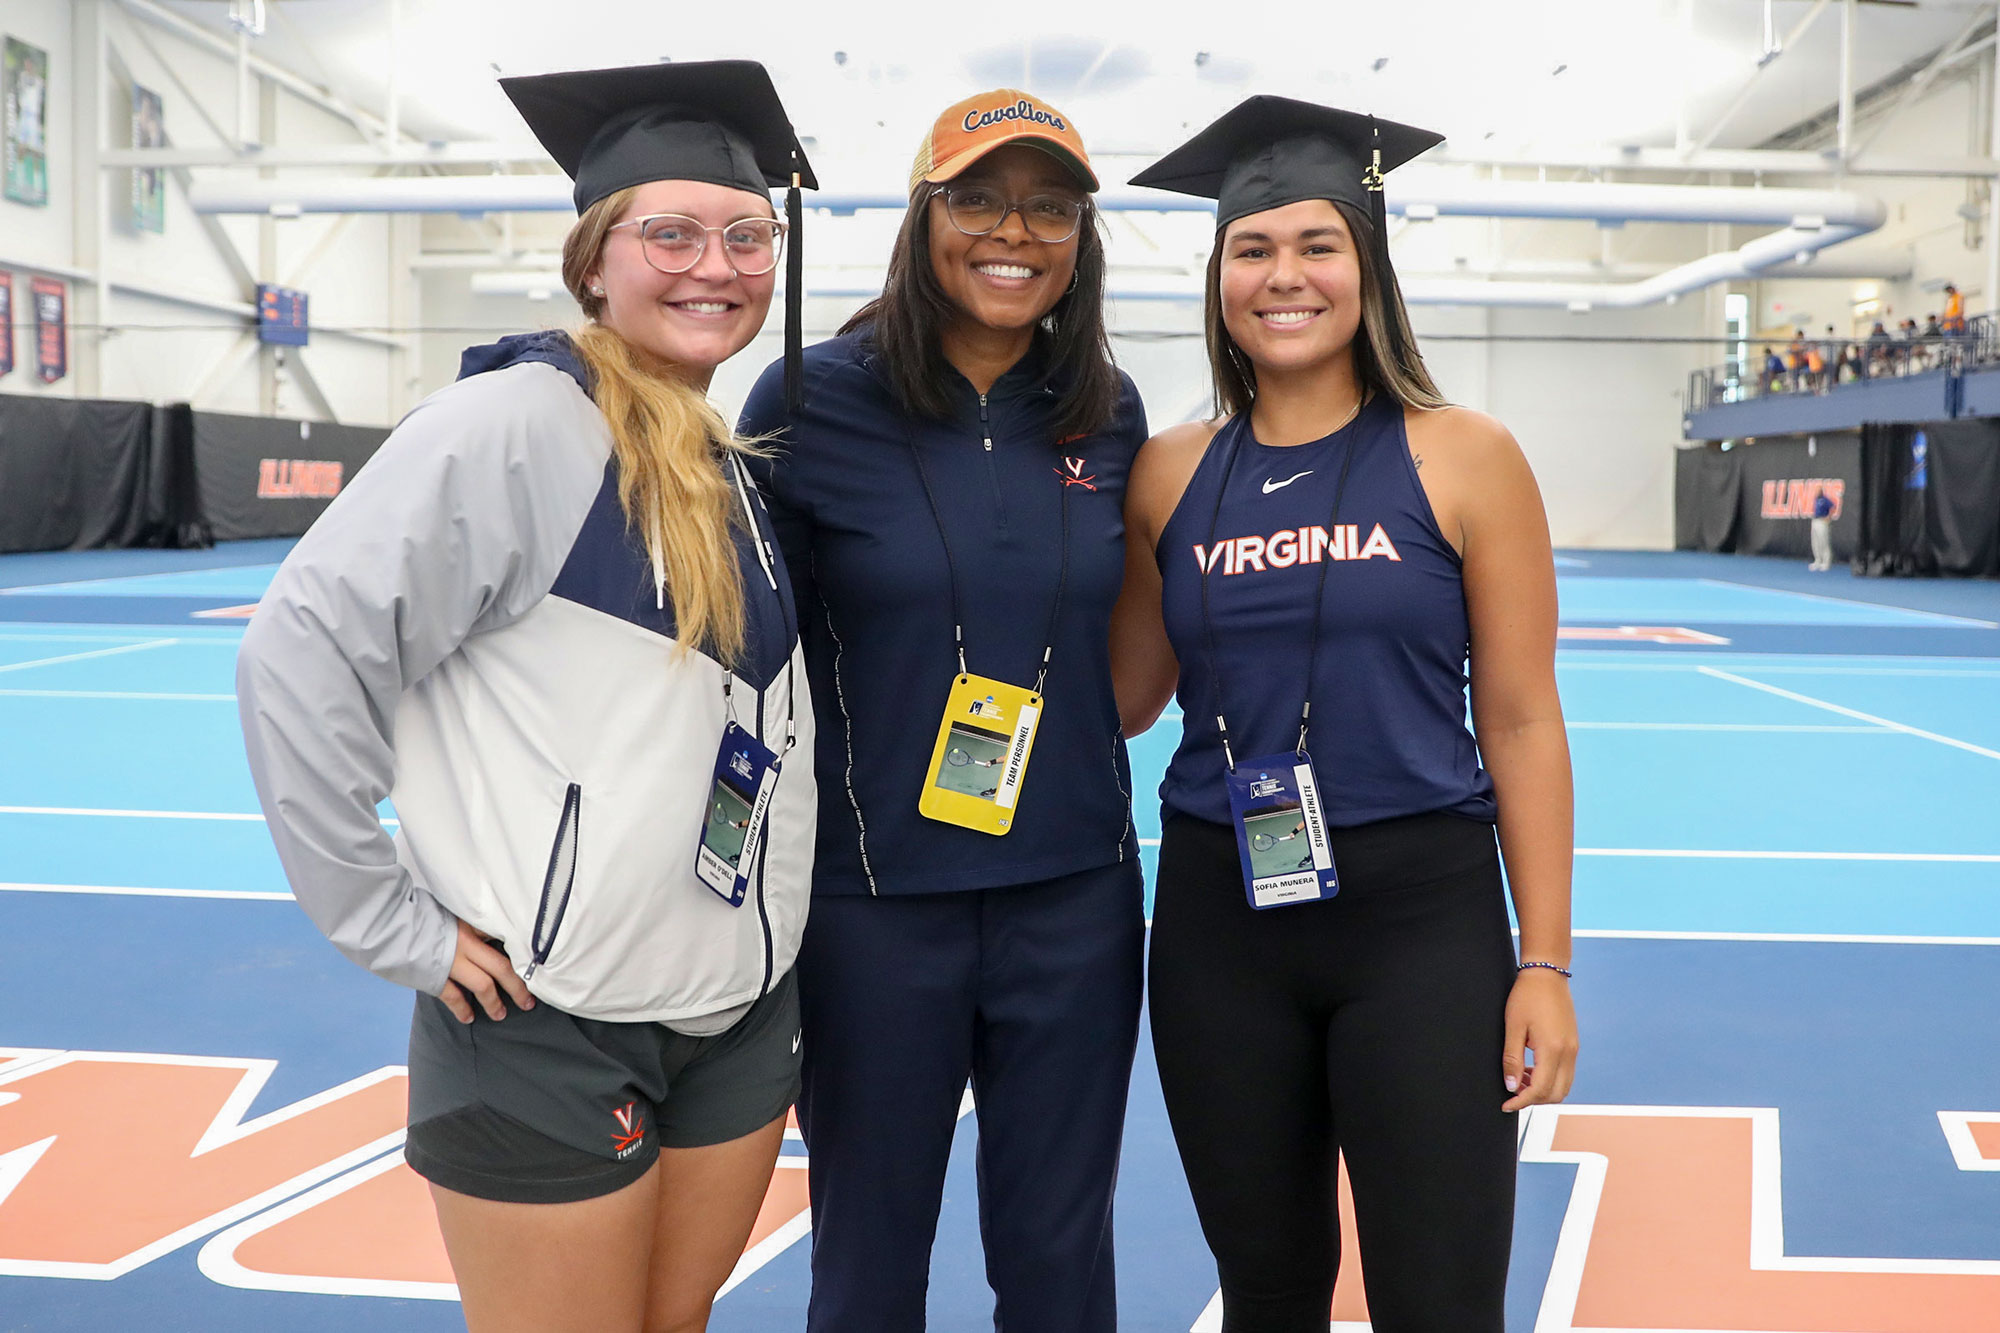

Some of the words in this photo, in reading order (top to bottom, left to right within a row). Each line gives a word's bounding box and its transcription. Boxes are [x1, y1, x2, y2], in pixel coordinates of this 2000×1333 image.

[962, 99, 1067, 132] Cavaliers
[1760, 478, 1846, 521] ILLINS
[1192, 522, 1403, 576] VIRGINIA
[1011, 726, 1030, 767] PERSONNEL
[1006, 767, 1018, 787] TEAM
[745, 789, 769, 856] STUDENT-ATHLETE
[1303, 785, 1324, 848] STUDENT-ATHLETE
[1255, 882, 1278, 892] SOFIA
[1280, 877, 1315, 888] MUNERA
[617, 1138, 643, 1160] TENNIS
